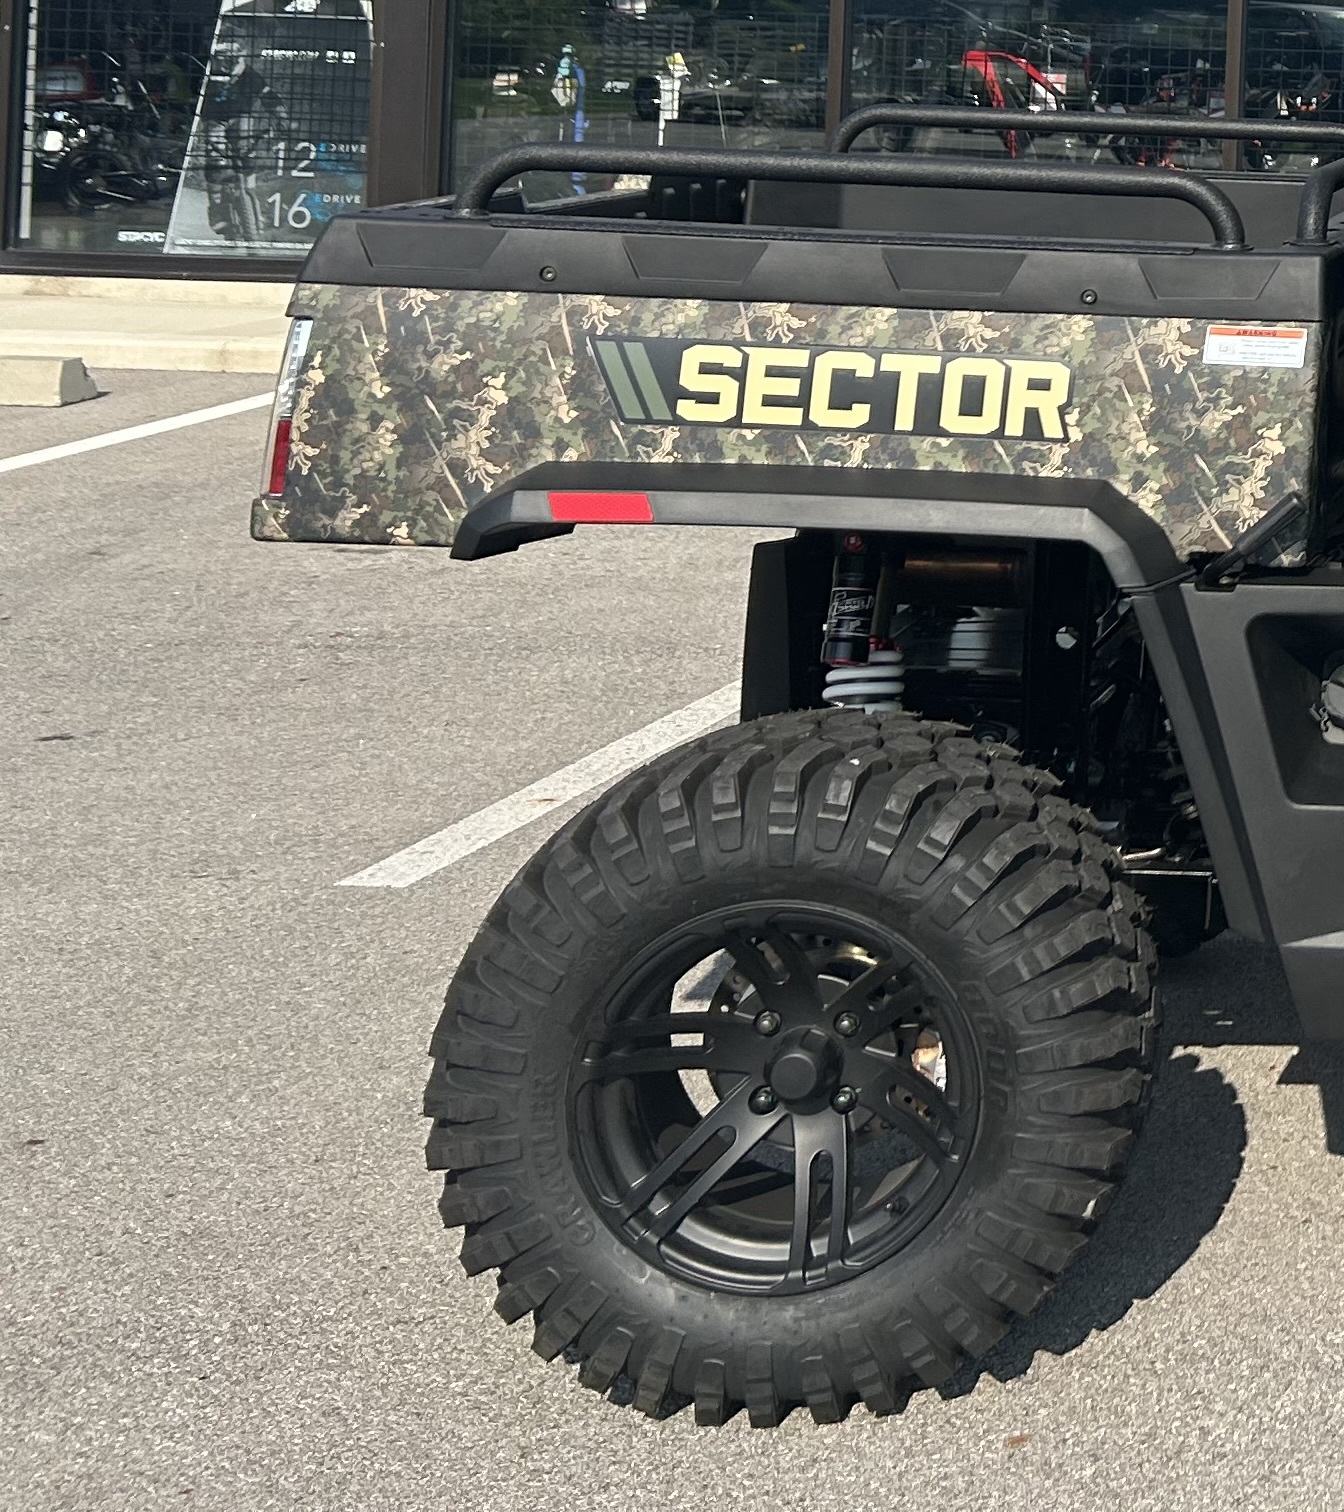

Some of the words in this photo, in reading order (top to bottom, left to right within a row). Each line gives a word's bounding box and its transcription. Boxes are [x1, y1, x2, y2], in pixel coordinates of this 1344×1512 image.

[272, 141, 316, 177] 12
[266, 192, 312, 229] 16
[675, 343, 1071, 440] SECTOR
